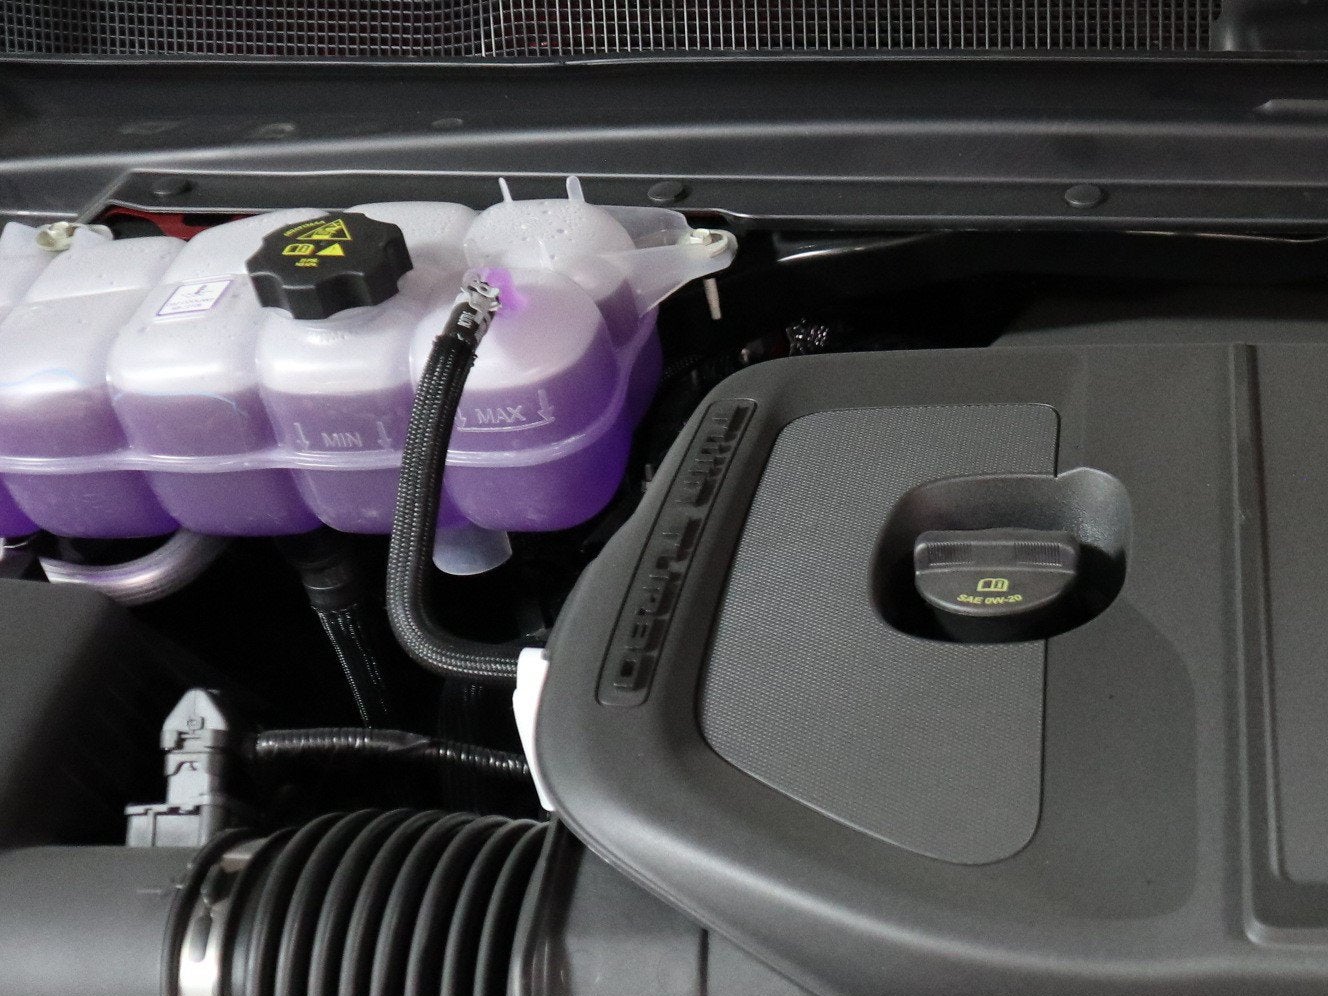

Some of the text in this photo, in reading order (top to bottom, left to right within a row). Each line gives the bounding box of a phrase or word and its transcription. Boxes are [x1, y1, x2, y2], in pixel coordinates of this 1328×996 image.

[475, 405, 527, 425] MAX
[321, 431, 362, 448] MIN
[956, 593, 1023, 605] SAE 0W-20
